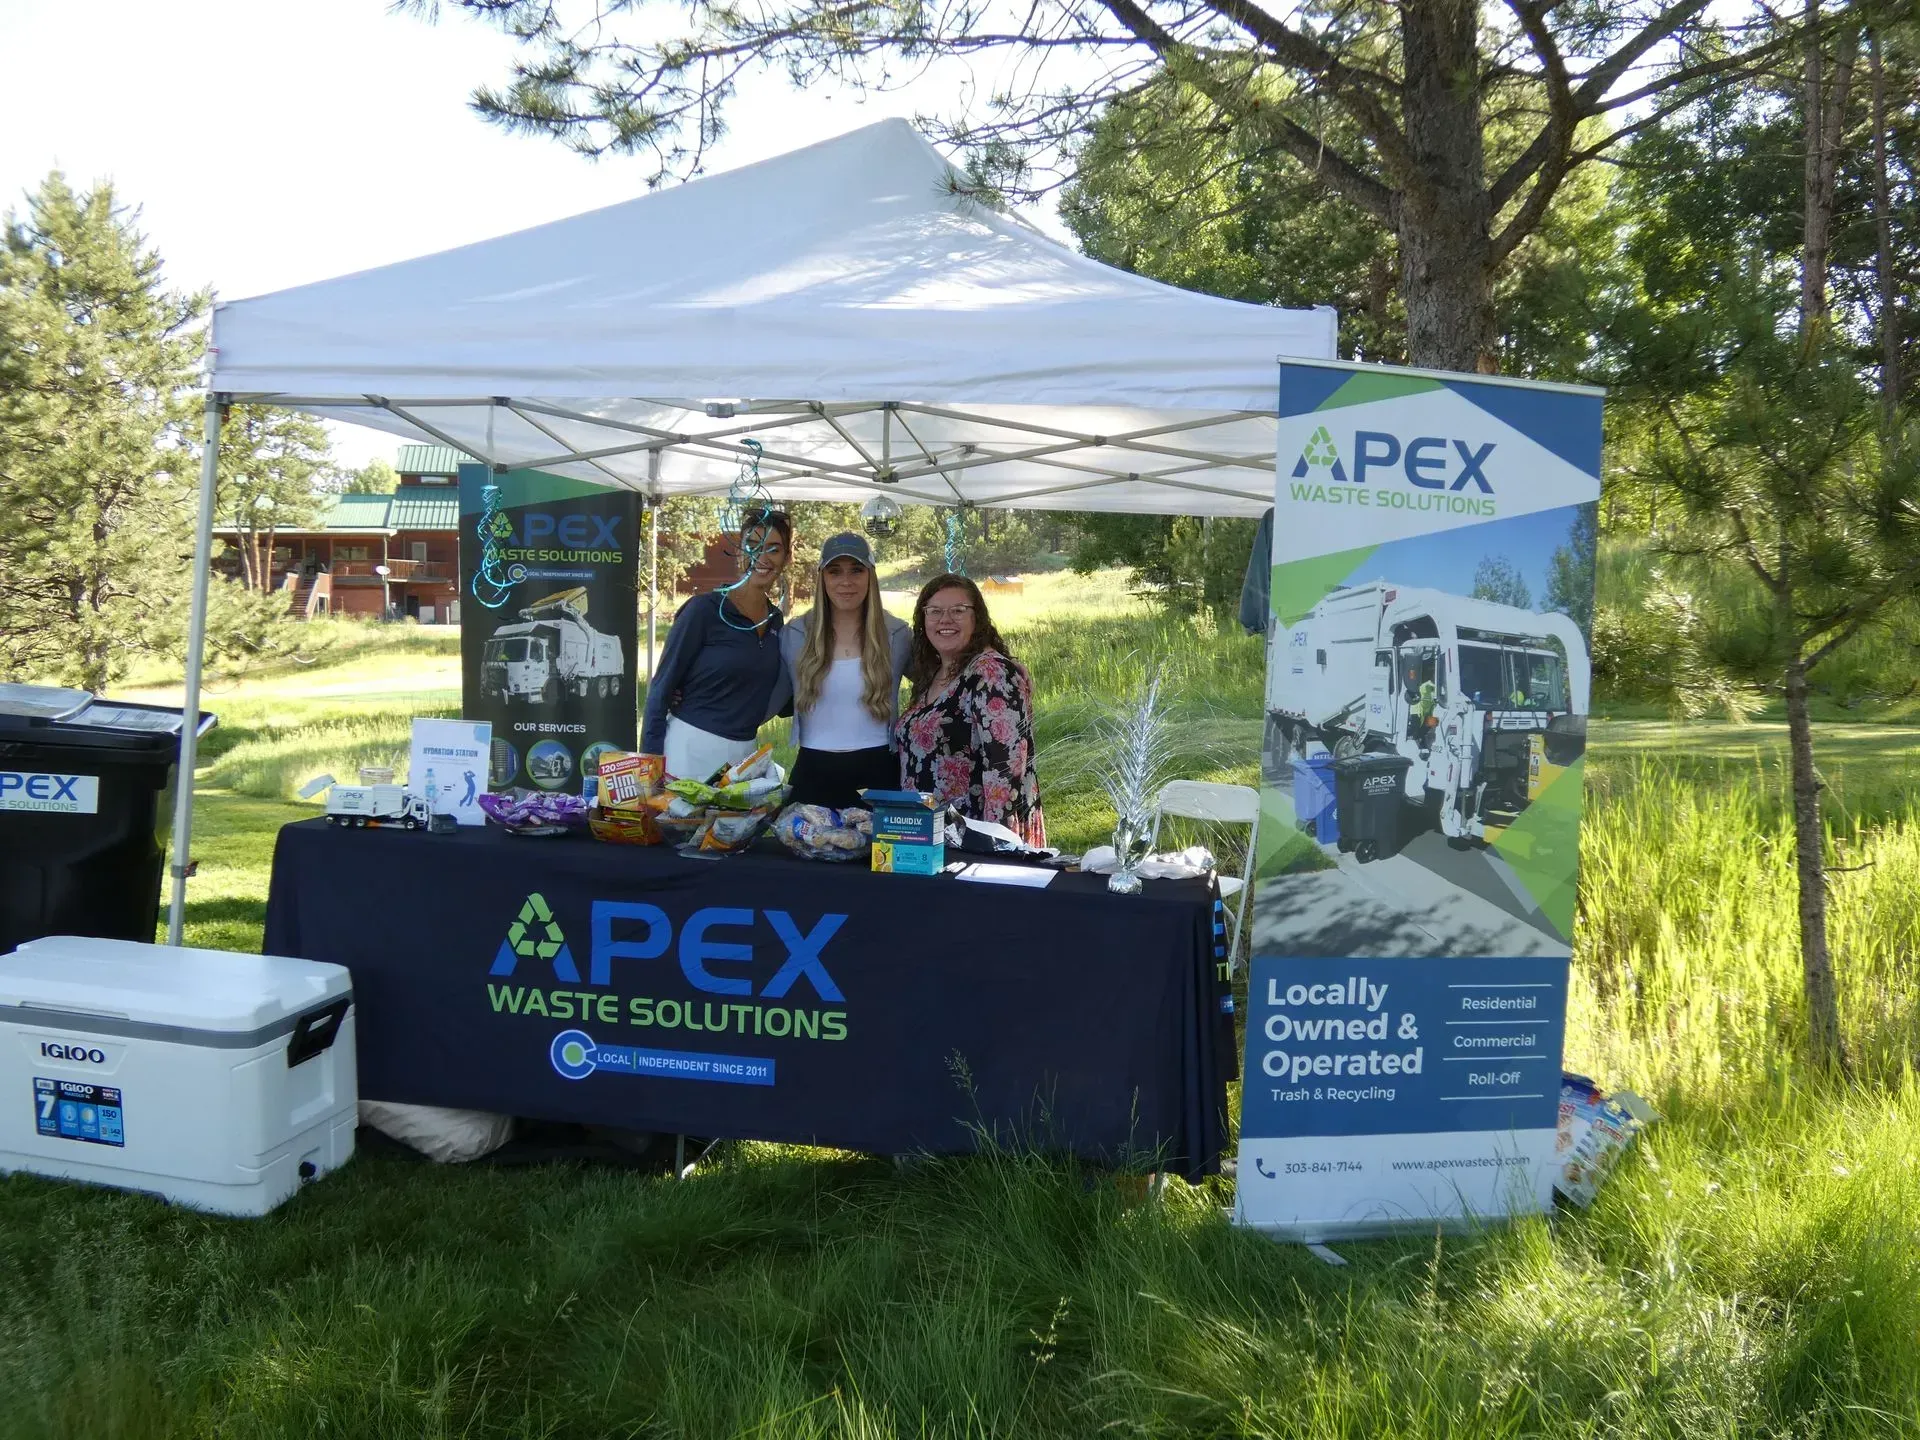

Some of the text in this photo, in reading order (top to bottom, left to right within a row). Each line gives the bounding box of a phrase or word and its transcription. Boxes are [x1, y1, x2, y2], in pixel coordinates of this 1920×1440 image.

[1291, 425, 1498, 495] APEX
[1290, 482, 1496, 517] WASTE SOLUTIONS
[483, 511, 623, 549] APEX
[539, 551, 623, 564] SOLUTIONS
[513, 722, 587, 733] OUR SERVICES
[455, 749, 478, 758] STATION
[601, 763, 617, 774] 120
[616, 758, 640, 767] ORIGINAL
[0, 773, 79, 801] PEX
[1363, 774, 1396, 787] APEX
[9, 800, 79, 811] SOLUTIONS
[890, 816, 913, 824] LIQUID
[489, 892, 850, 1003] APEX
[1267, 976, 1389, 1012] Locally
[1462, 996, 1537, 1010] Residential
[487, 984, 849, 1042] WASTE SOLUTIONS
[1264, 1012, 1420, 1042] Owned &
[1453, 1034, 1536, 1048] Commercial
[41, 1042, 105, 1064] IGLOO
[597, 1052, 768, 1077] LOCAL INDEPENDENT SINCE 2011
[1262, 1047, 1424, 1084] Operated
[1468, 1072, 1521, 1086] Roll-Off
[60, 1082, 94, 1095] IGLOO
[1270, 1087, 1396, 1103] Trash & Recycling
[38, 1094, 55, 1119] 7
[102, 1109, 117, 1119] 150
[40, 1119, 56, 1128] DAYS
[1285, 1155, 1531, 1174] 303-841-7144 www.apexwasteco.com
